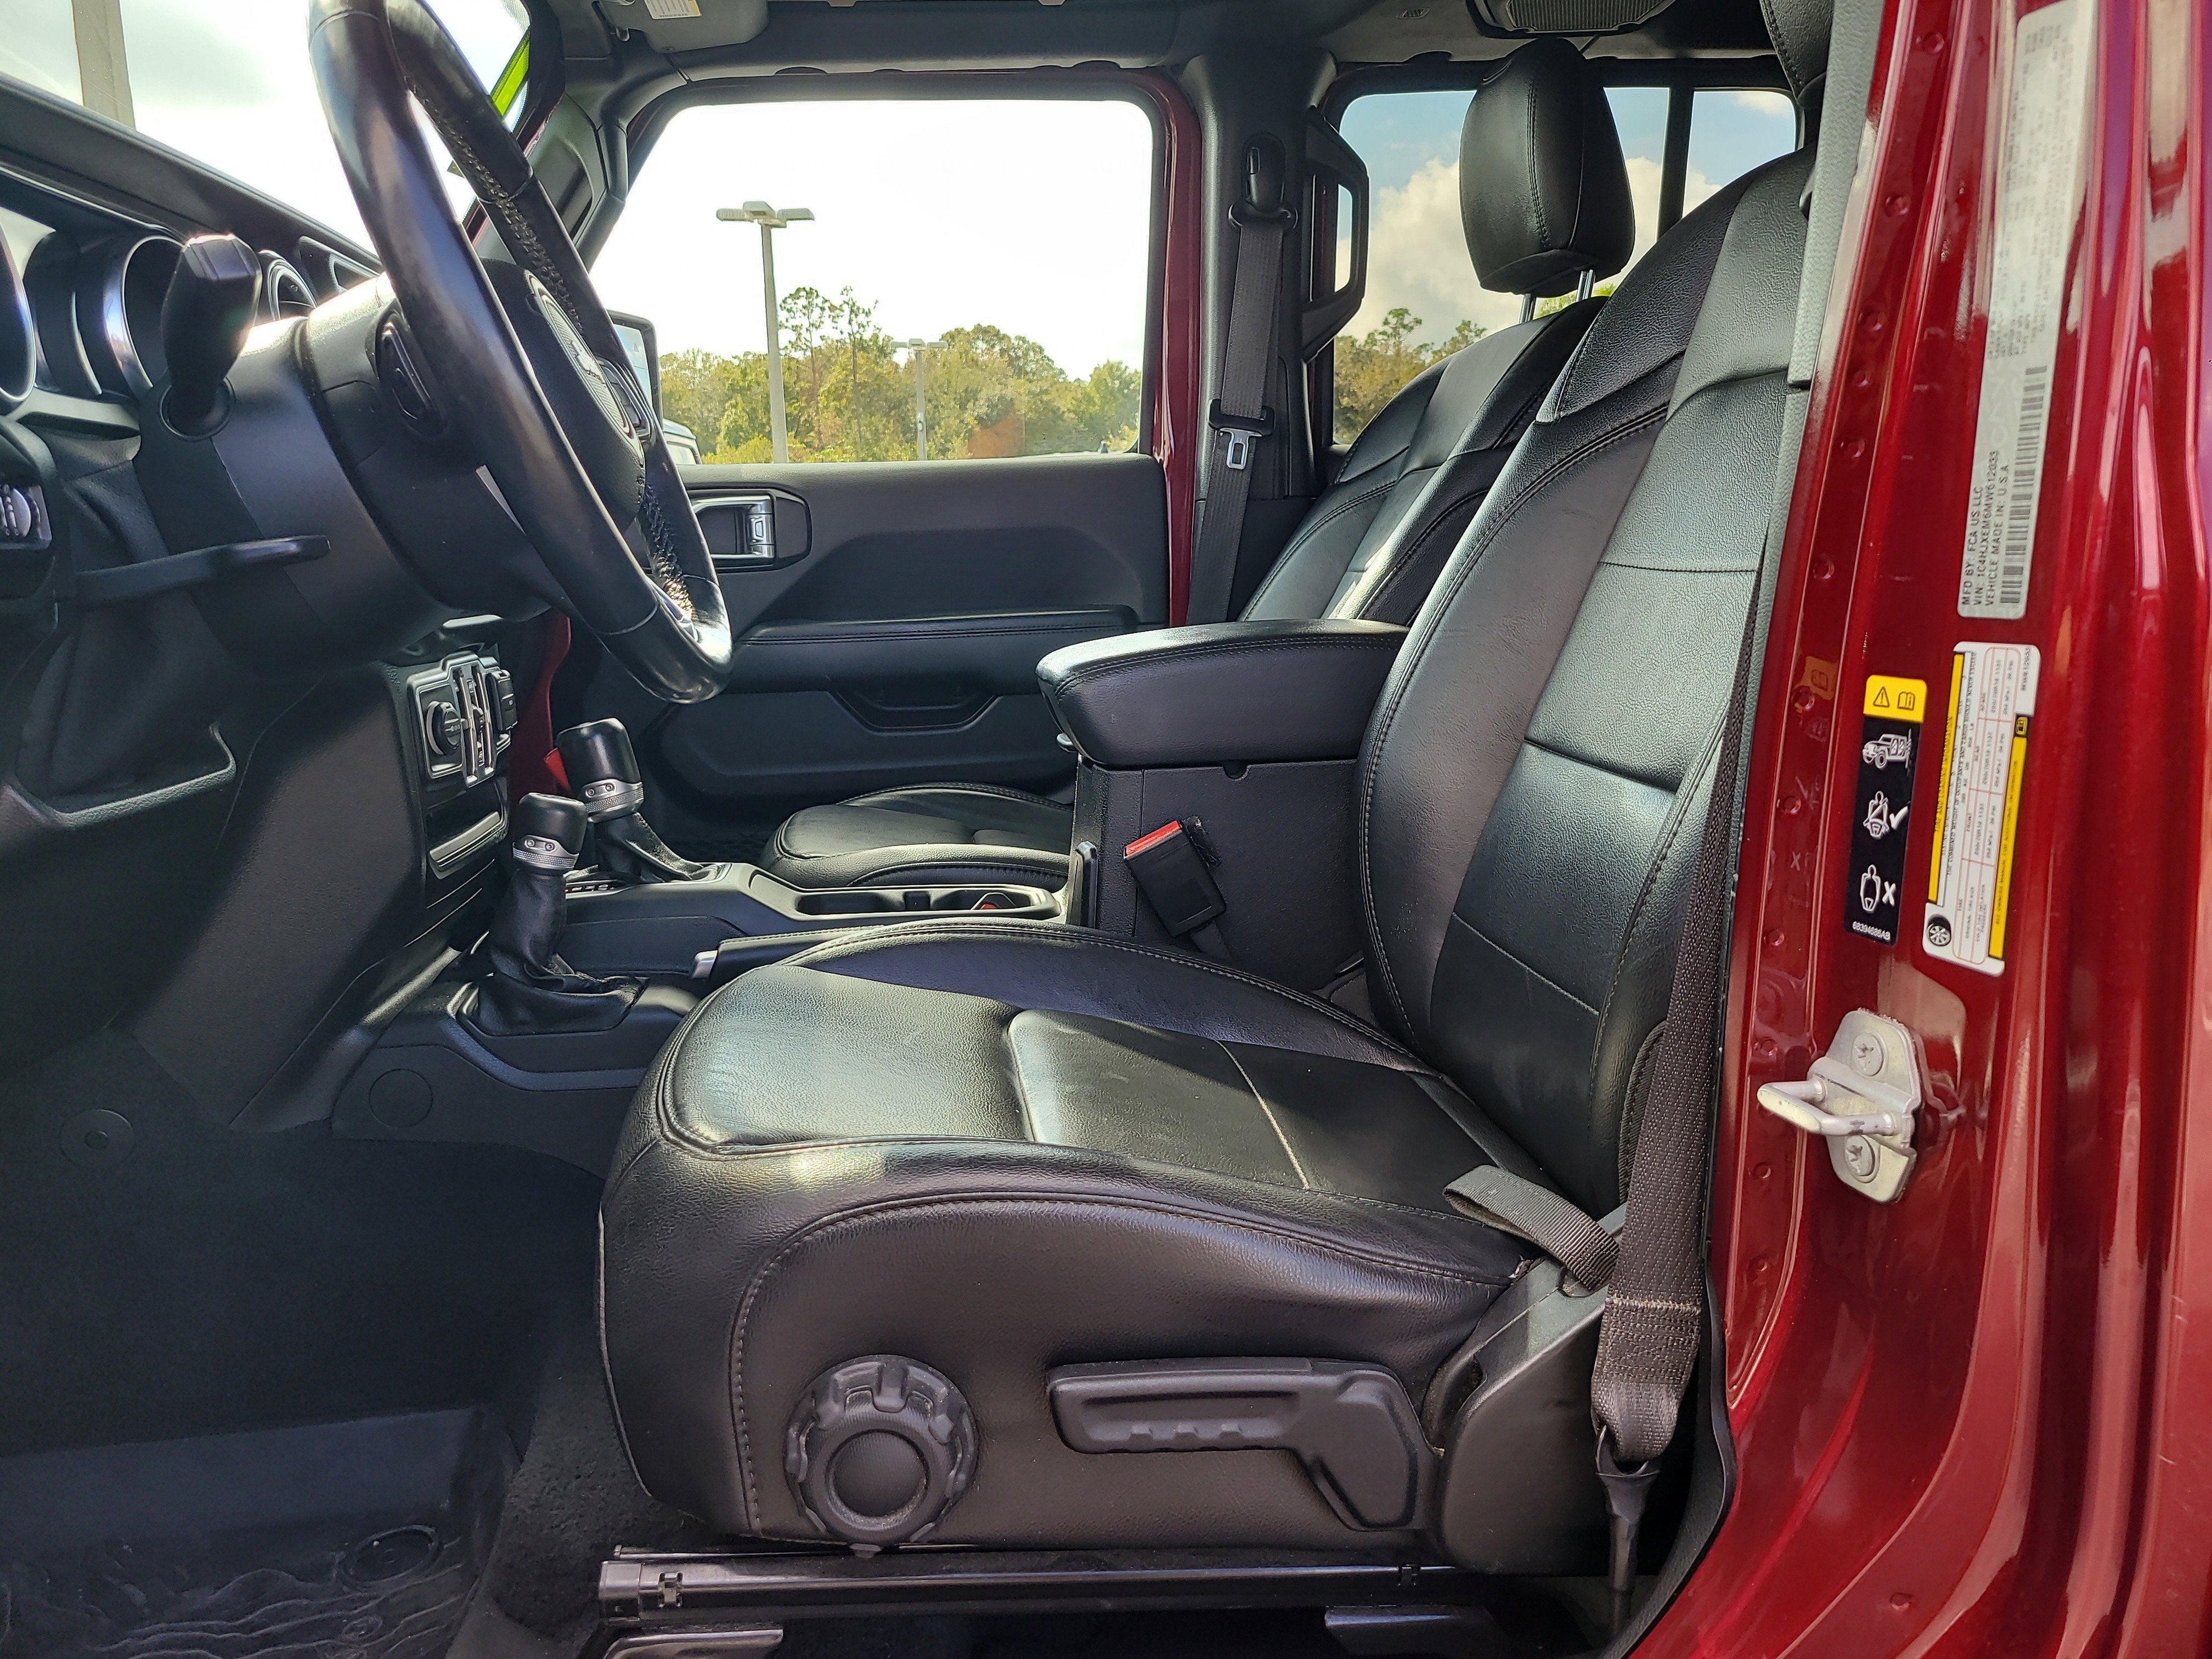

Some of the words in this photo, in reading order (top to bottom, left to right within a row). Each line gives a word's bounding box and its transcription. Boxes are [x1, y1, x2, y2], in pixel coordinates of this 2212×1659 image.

[1971, 486, 1983, 507] LLC
[1971, 510, 1980, 527] US
[1967, 531, 1978, 552] FCA
[1990, 521, 2003, 555] MADE
[1984, 559, 1999, 607] VEHICLE
